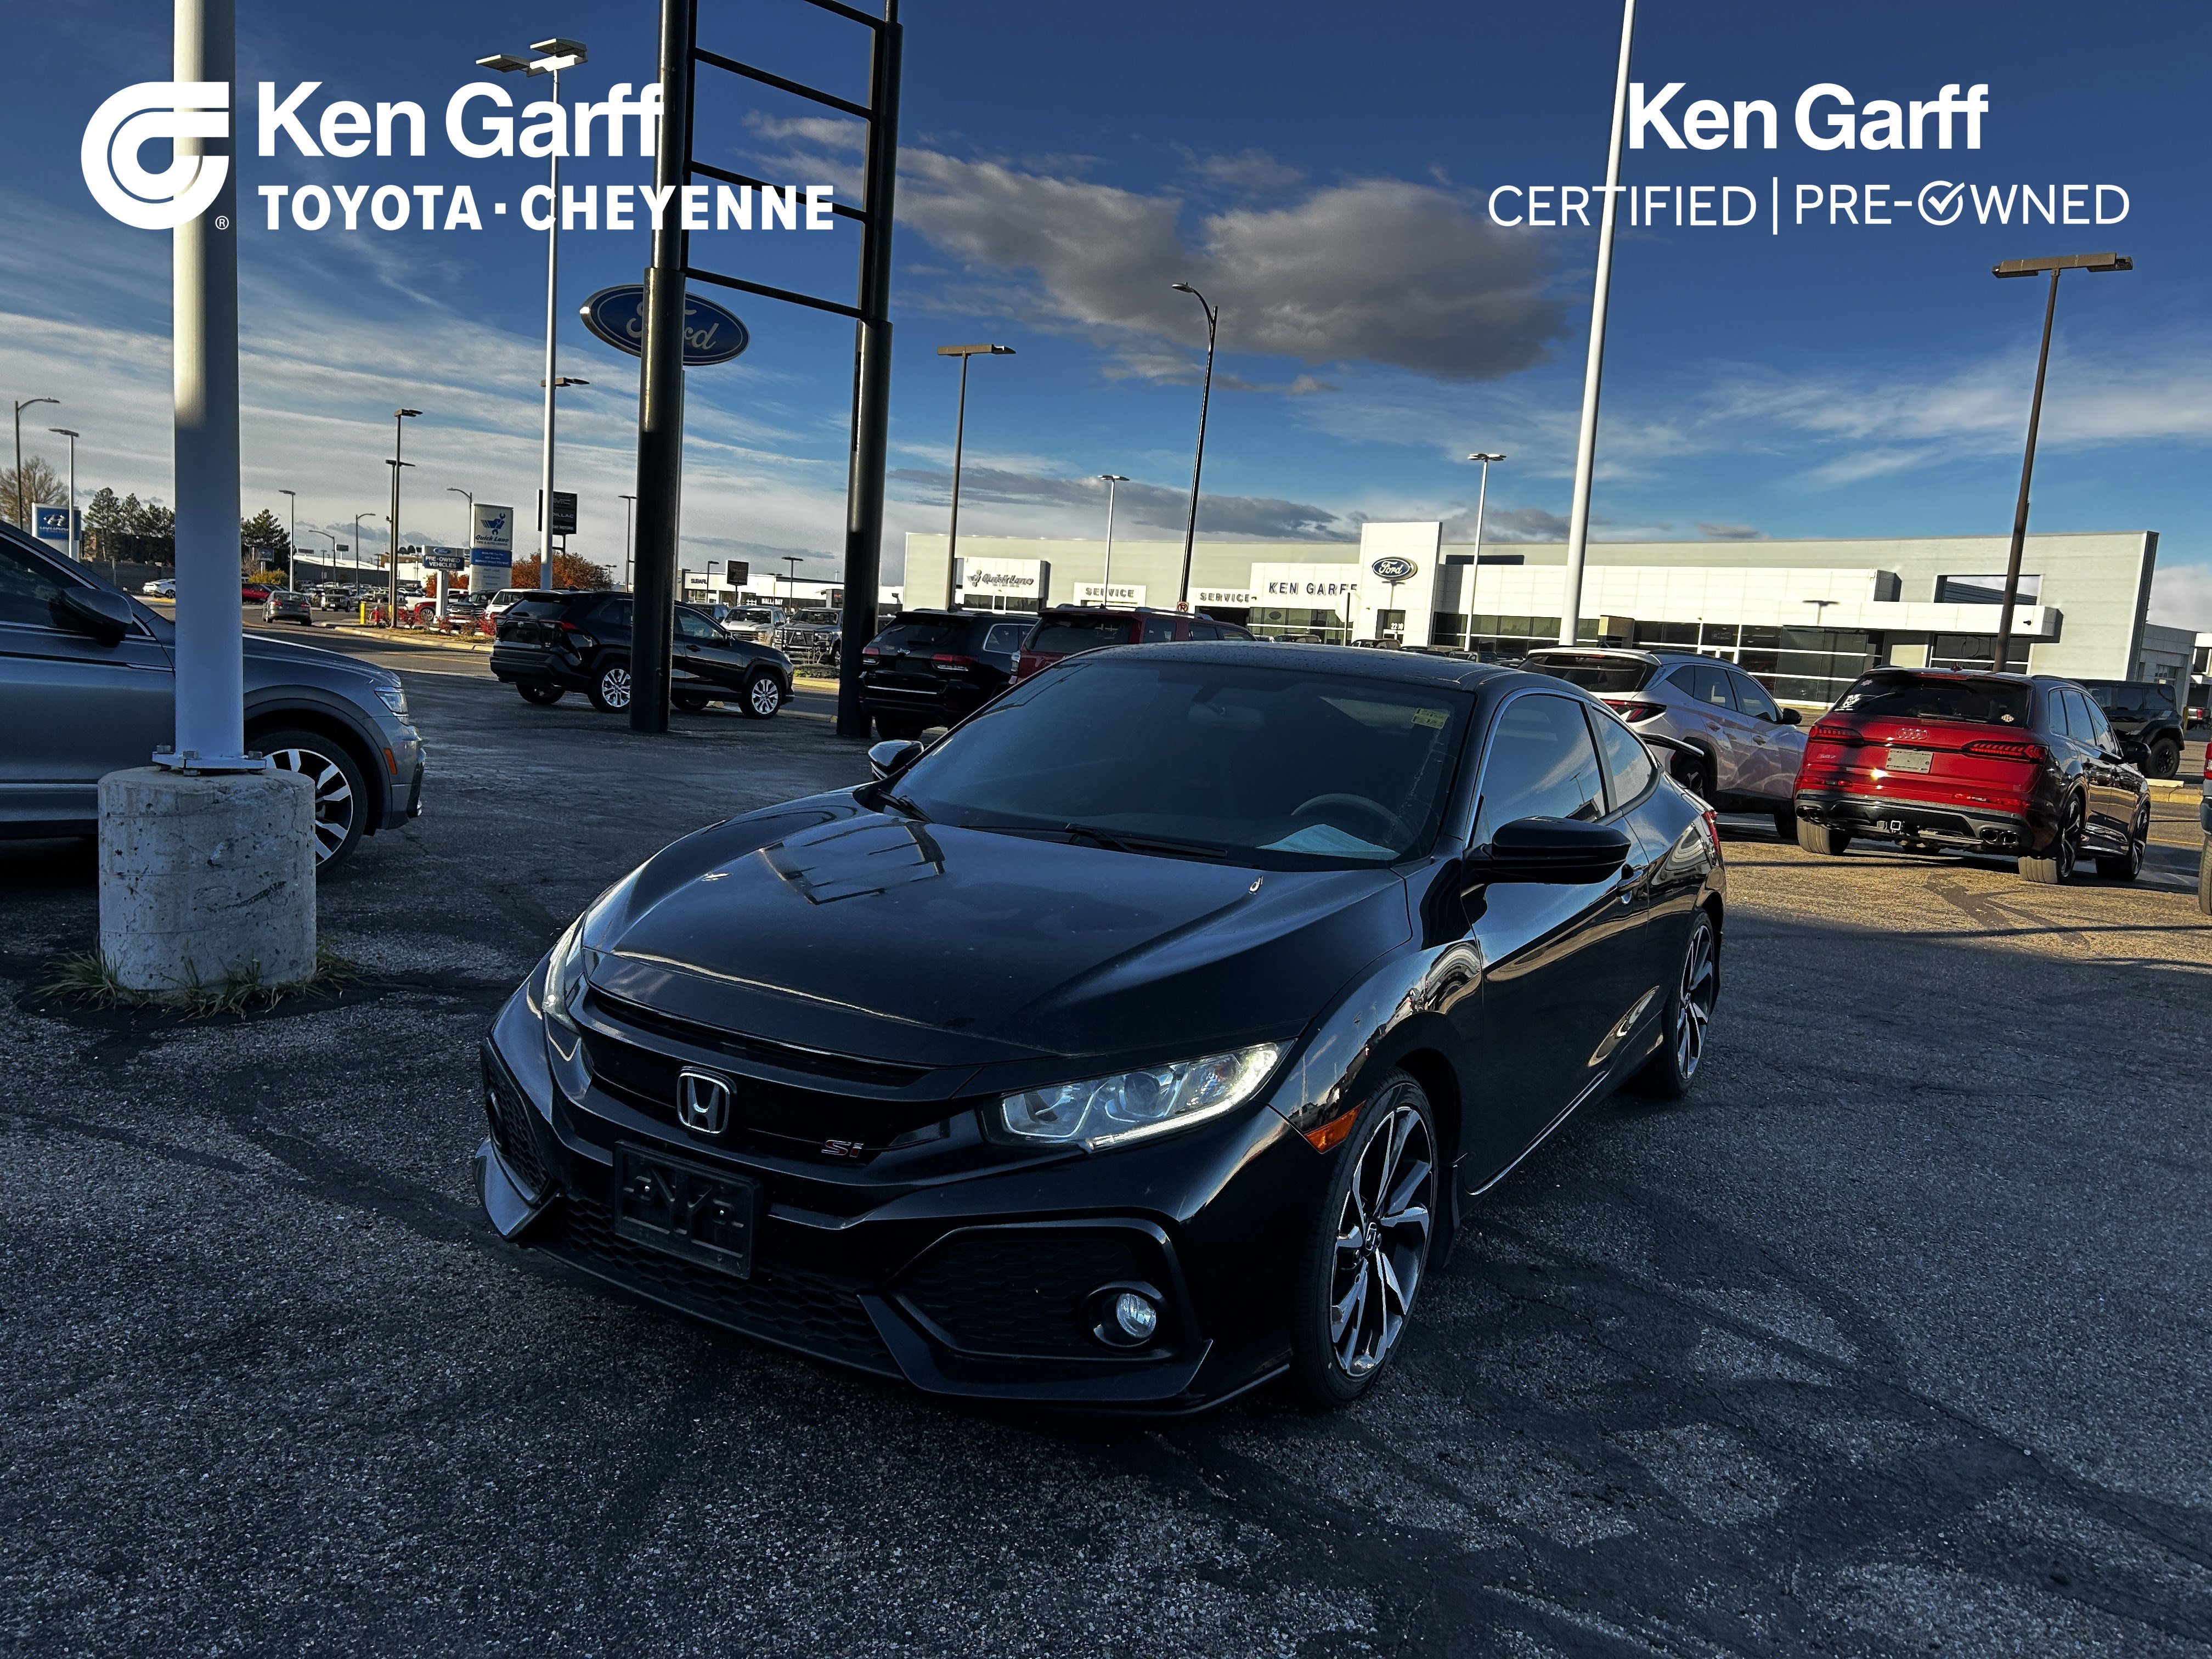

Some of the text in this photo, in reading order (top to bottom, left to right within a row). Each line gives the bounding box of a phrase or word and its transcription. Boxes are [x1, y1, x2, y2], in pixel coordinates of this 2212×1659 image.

[1378, 561, 1403, 575] Ford
[981, 573, 1009, 584] Quick
[1009, 574, 1034, 585] Lane
[1268, 582, 1299, 595] KEN
[1200, 592, 1250, 603] SERVICE
[821, 1139, 864, 1158] Si
